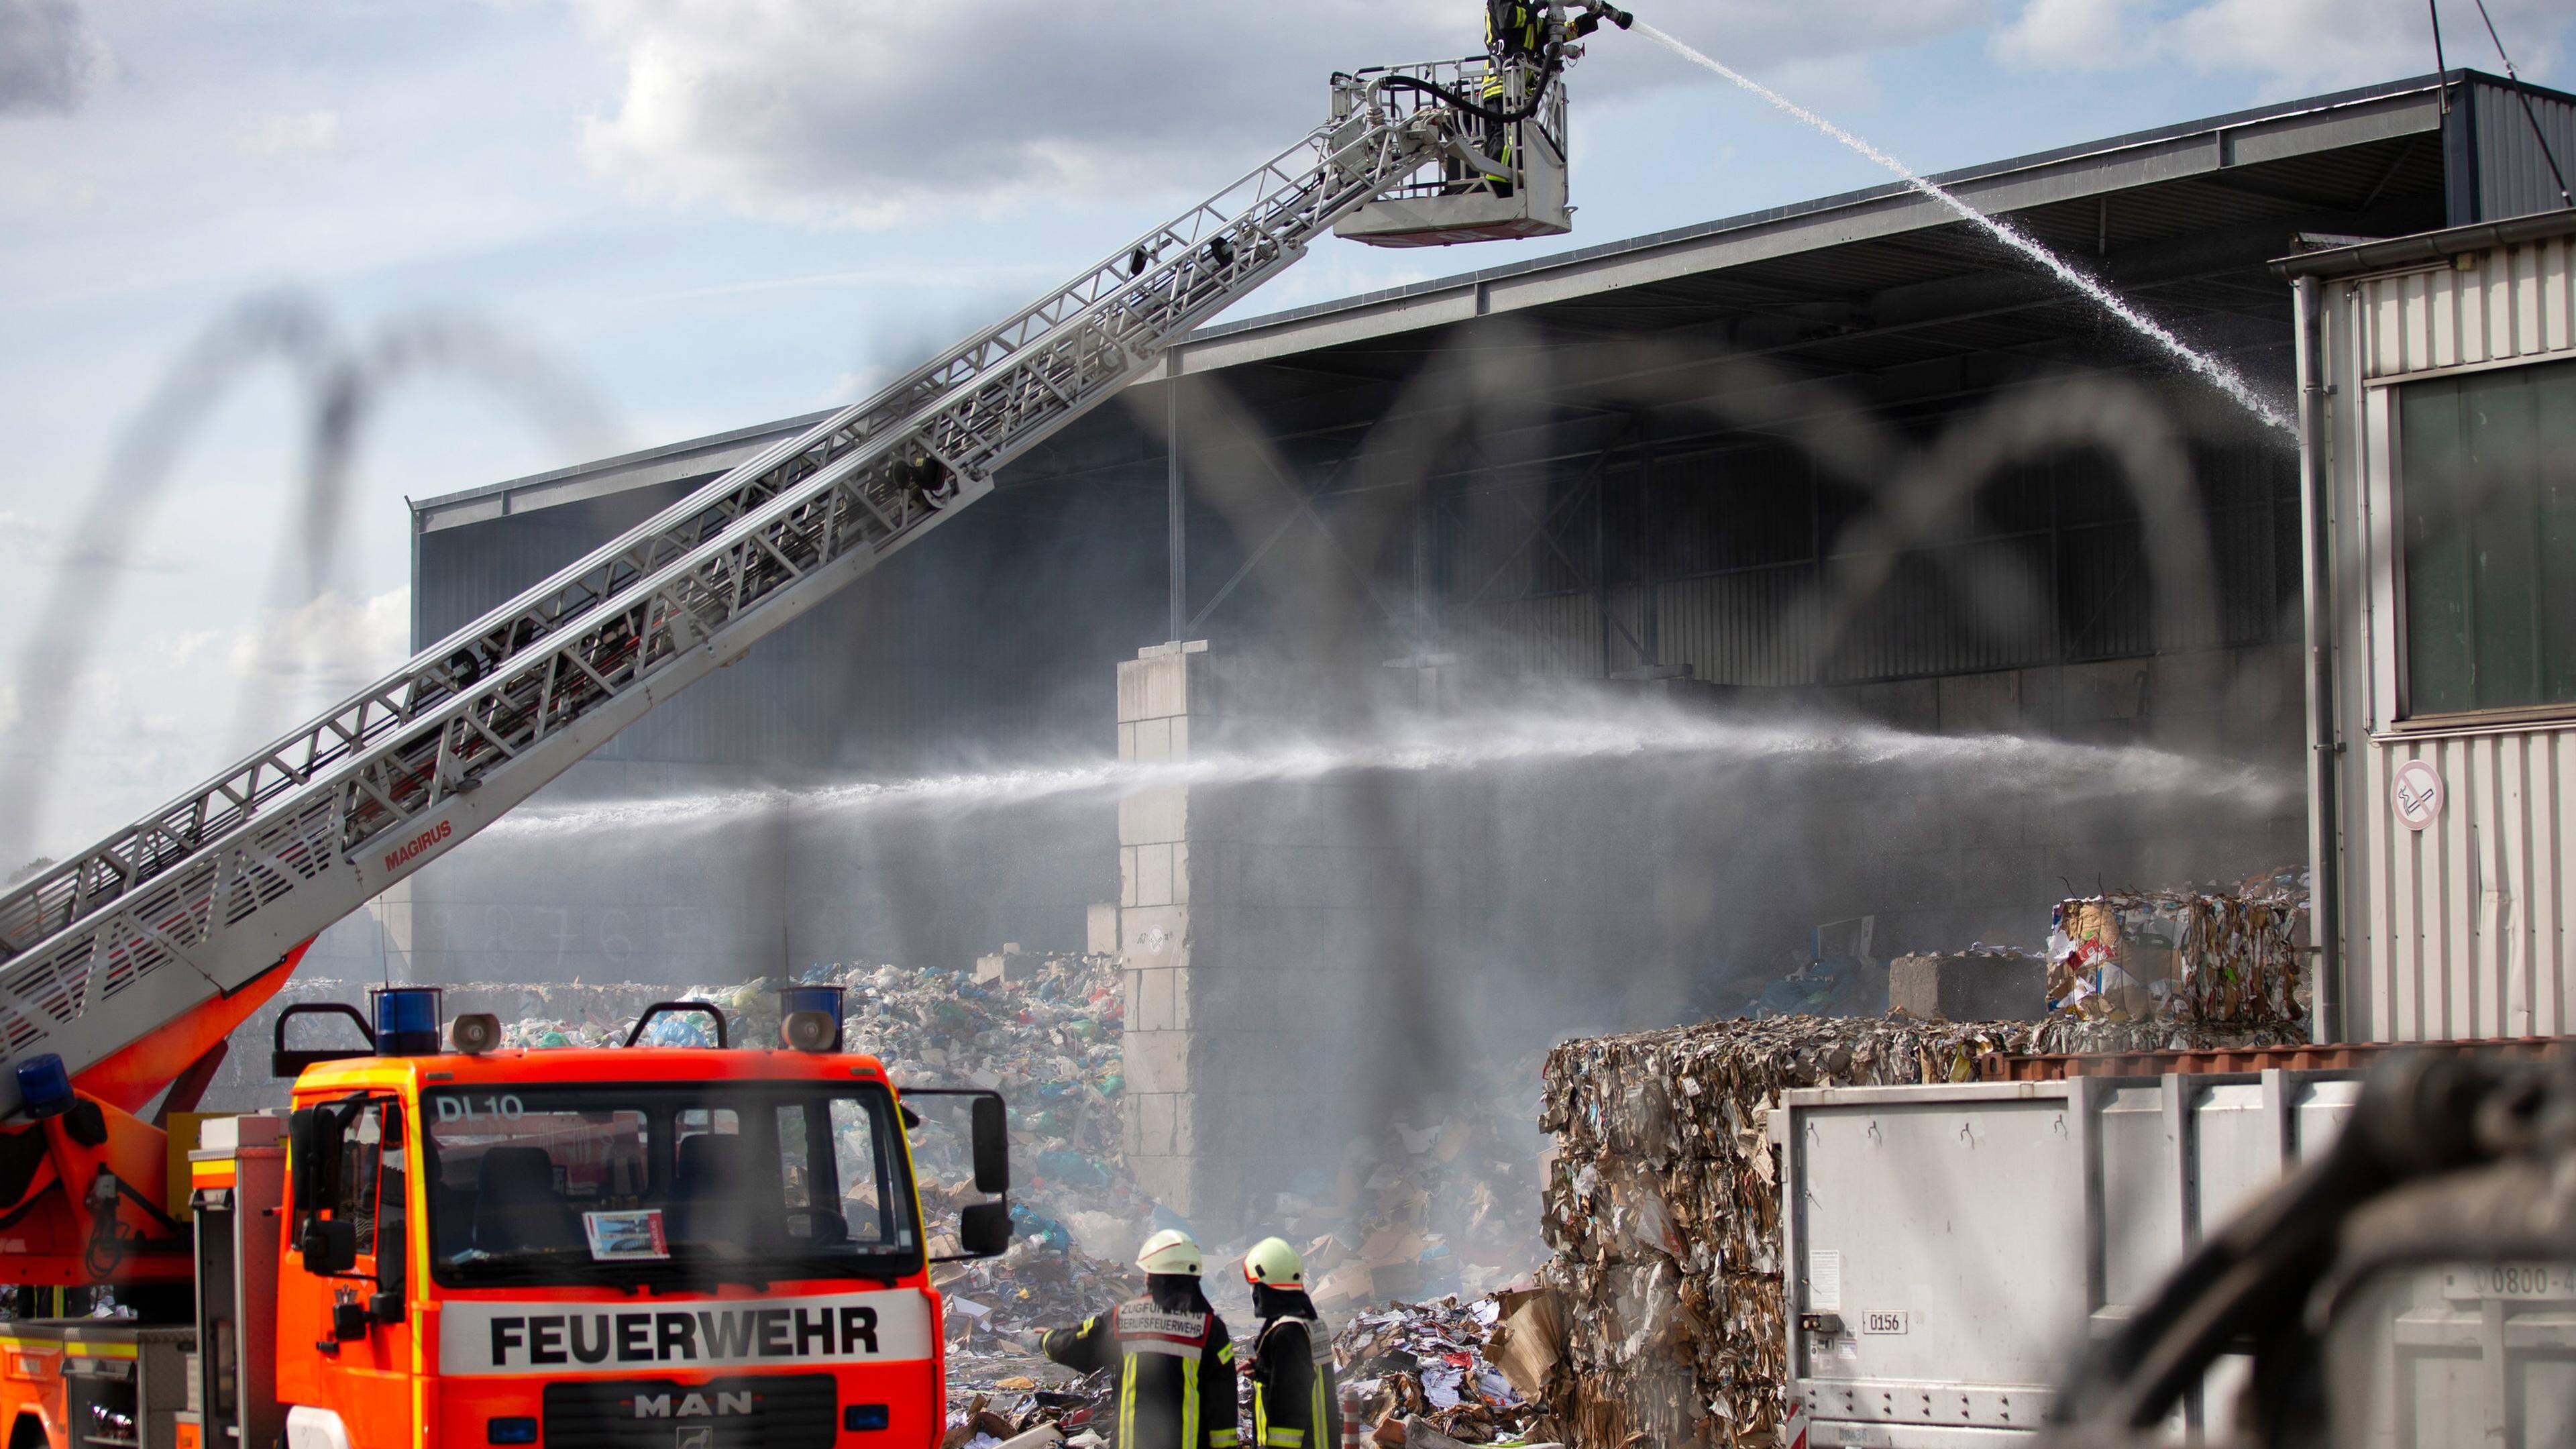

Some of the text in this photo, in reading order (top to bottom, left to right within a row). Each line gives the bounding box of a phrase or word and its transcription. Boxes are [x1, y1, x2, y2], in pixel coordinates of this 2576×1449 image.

[384, 819, 451, 872] MAGIRUS
[490, 1307, 879, 1365] FEUERWEHR
[1870, 1314, 1899, 1330] 0156
[635, 1391, 751, 1418] MAN
